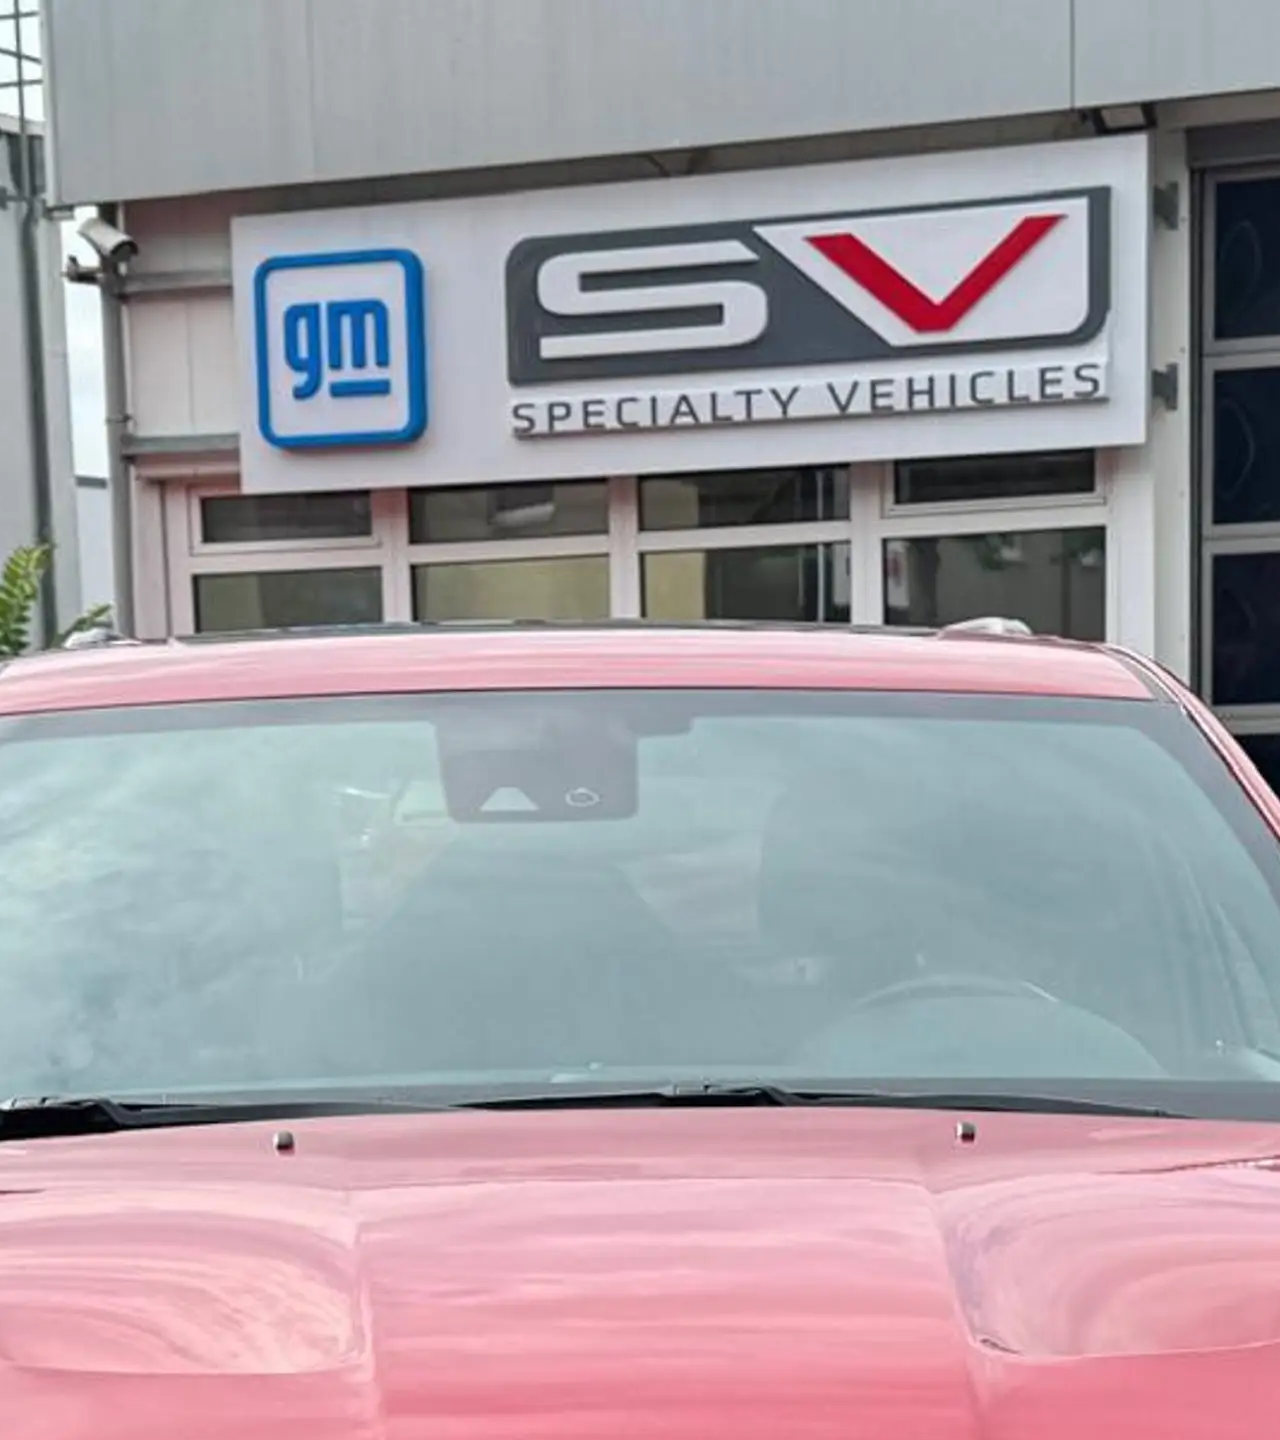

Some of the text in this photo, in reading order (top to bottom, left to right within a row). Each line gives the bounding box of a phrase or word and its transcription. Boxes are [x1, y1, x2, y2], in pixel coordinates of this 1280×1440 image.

[535, 200, 1085, 361] SV
[283, 298, 392, 401] gm
[511, 362, 1103, 436] SPECIALTY VEHICLES
